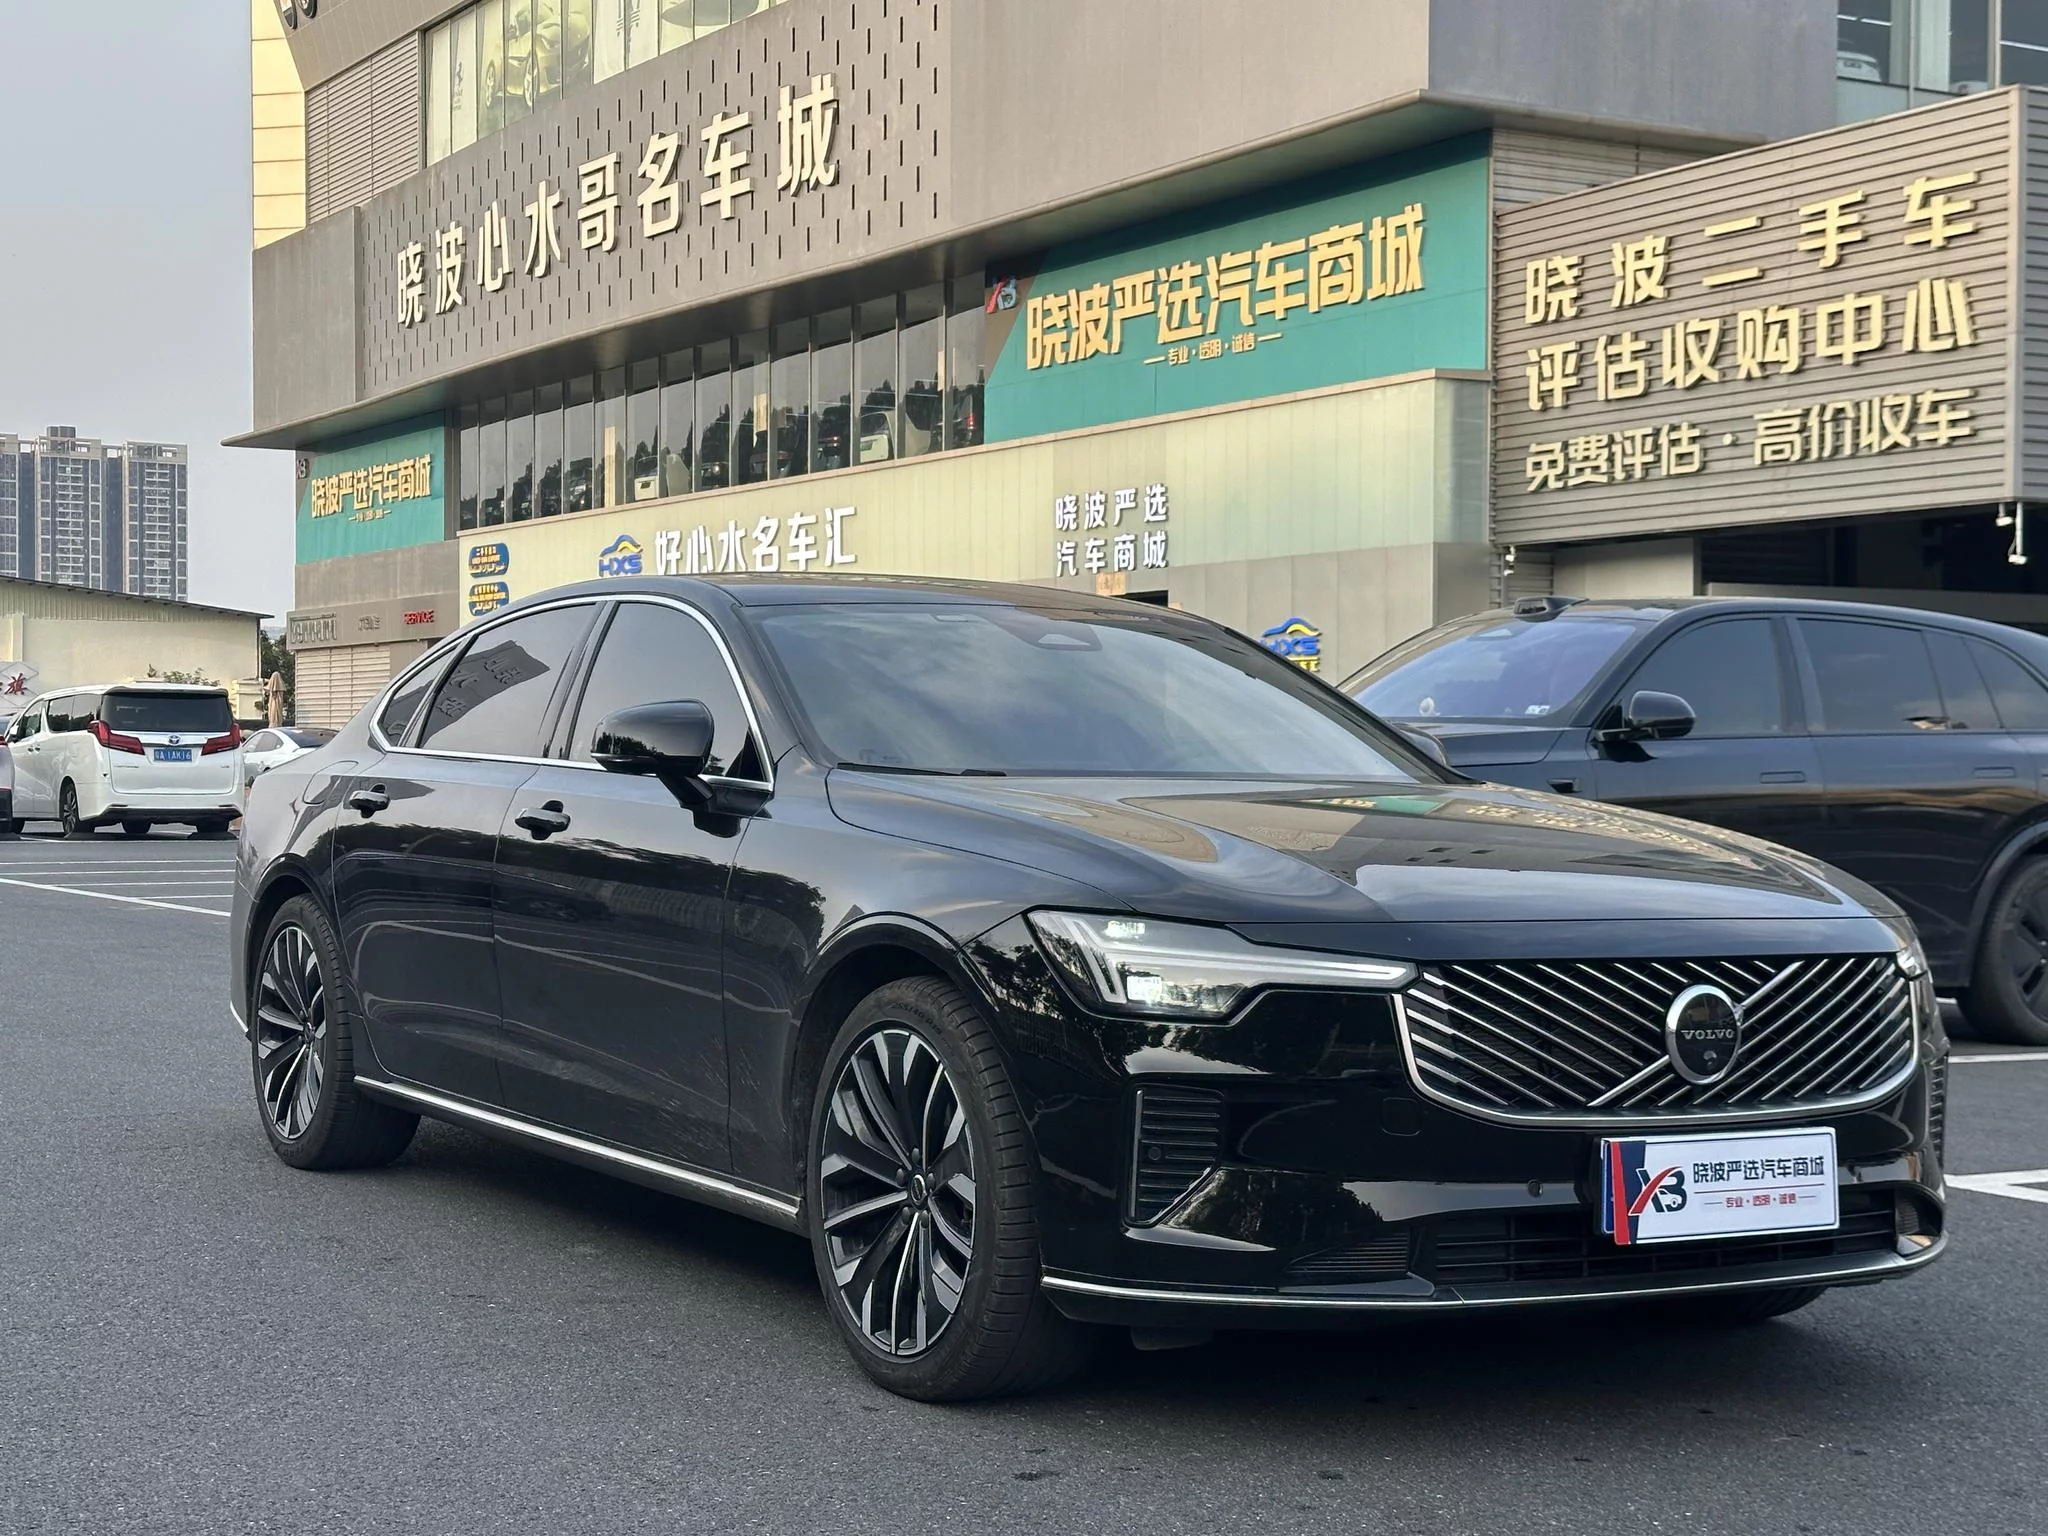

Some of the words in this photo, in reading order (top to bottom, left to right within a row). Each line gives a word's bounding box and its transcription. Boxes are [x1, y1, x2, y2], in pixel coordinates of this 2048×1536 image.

[397, 73, 838, 328] 晓波心水哥名车城
[1526, 170, 1979, 324] 晓波二手车
[1026, 202, 1427, 370] 晓波严选汽车商城
[1526, 277, 1976, 411] 评估收购中心
[312, 453, 432, 518] 晓波严选汽车商城
[1055, 482, 1169, 531] 晓波严选
[655, 506, 858, 576] 好心水名车汇
[1055, 530, 1169, 577] 汽车商城
[1681, 1029, 1735, 1040] VOLVO
[1693, 1156, 1825, 1184] 晓波严选汽车商城
